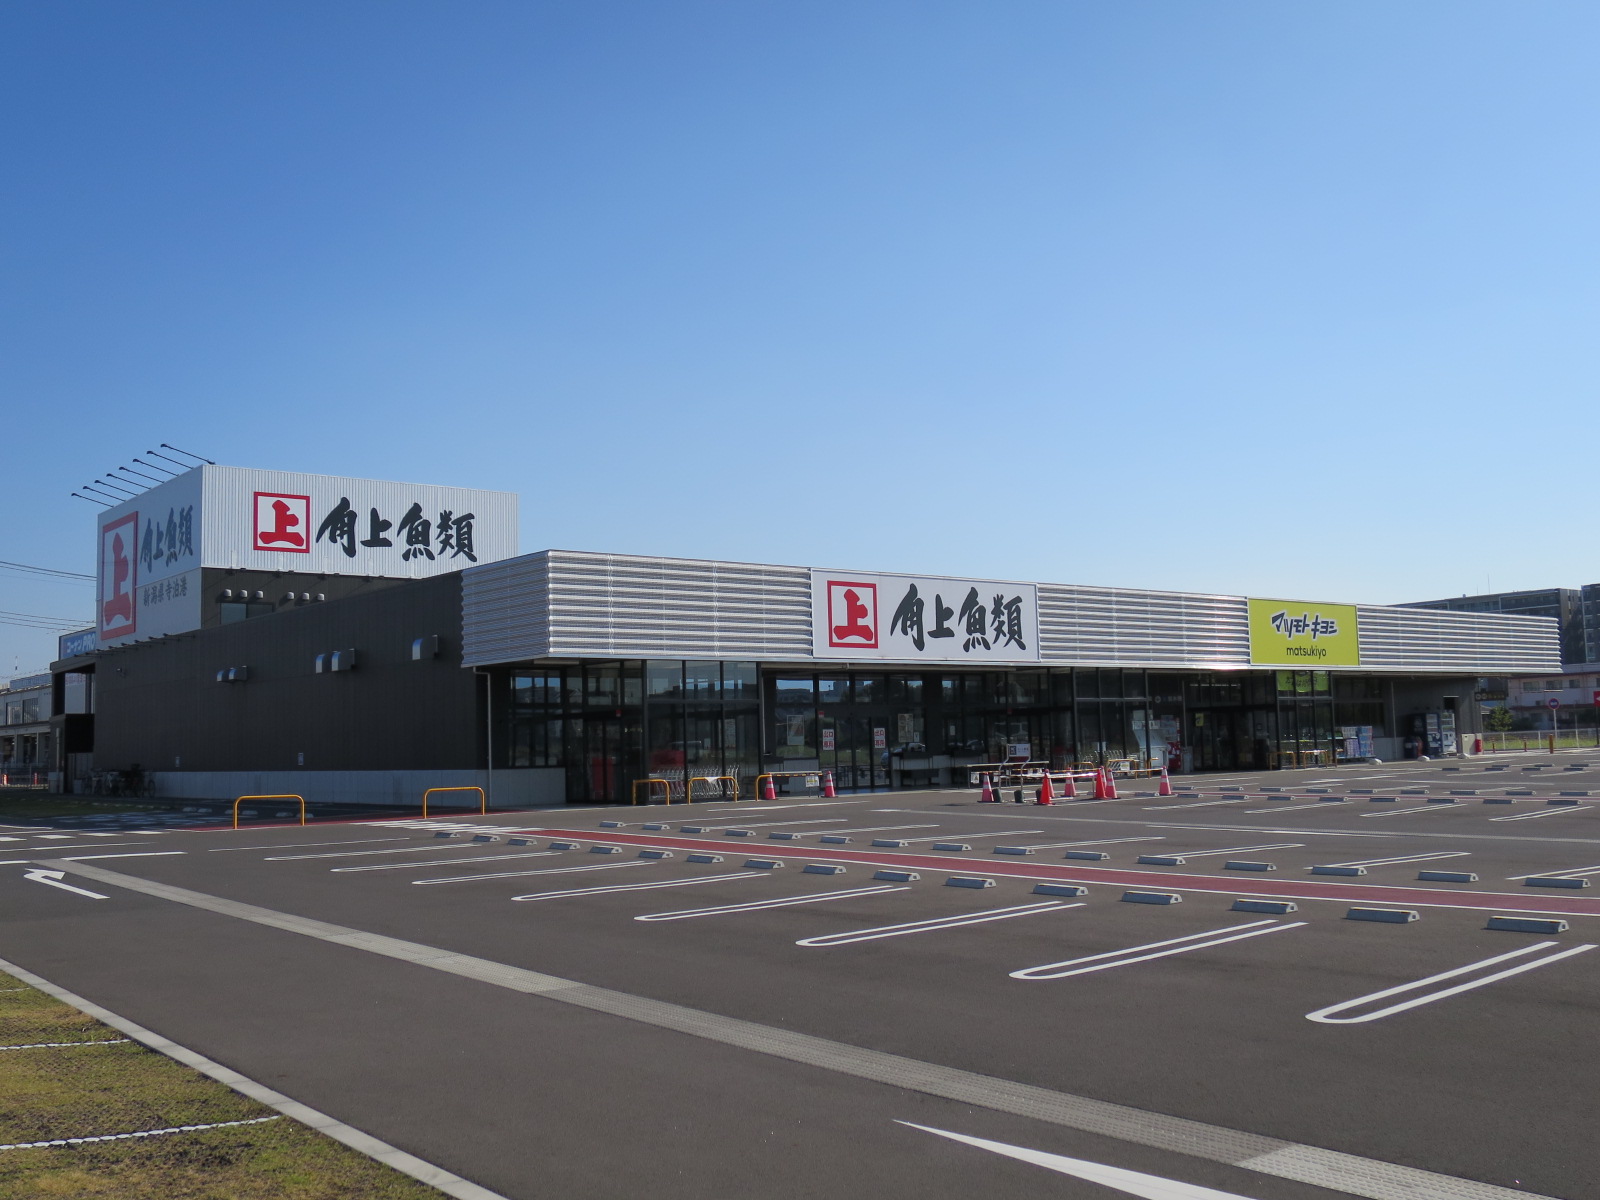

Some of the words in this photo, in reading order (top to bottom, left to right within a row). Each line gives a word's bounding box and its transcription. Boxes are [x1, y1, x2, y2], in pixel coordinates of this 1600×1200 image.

[140, 504, 193, 574] 角上魚類
[259, 499, 305, 547] 上
[316, 496, 477, 562] 角上魚類
[143, 575, 187, 607] 新潟県寺泊港
[833, 588, 875, 641] 上
[82, 633, 96, 651] PRO
[890, 583, 1026, 652] 角上魚類
[1286, 645, 1327, 659] matsukiyo
